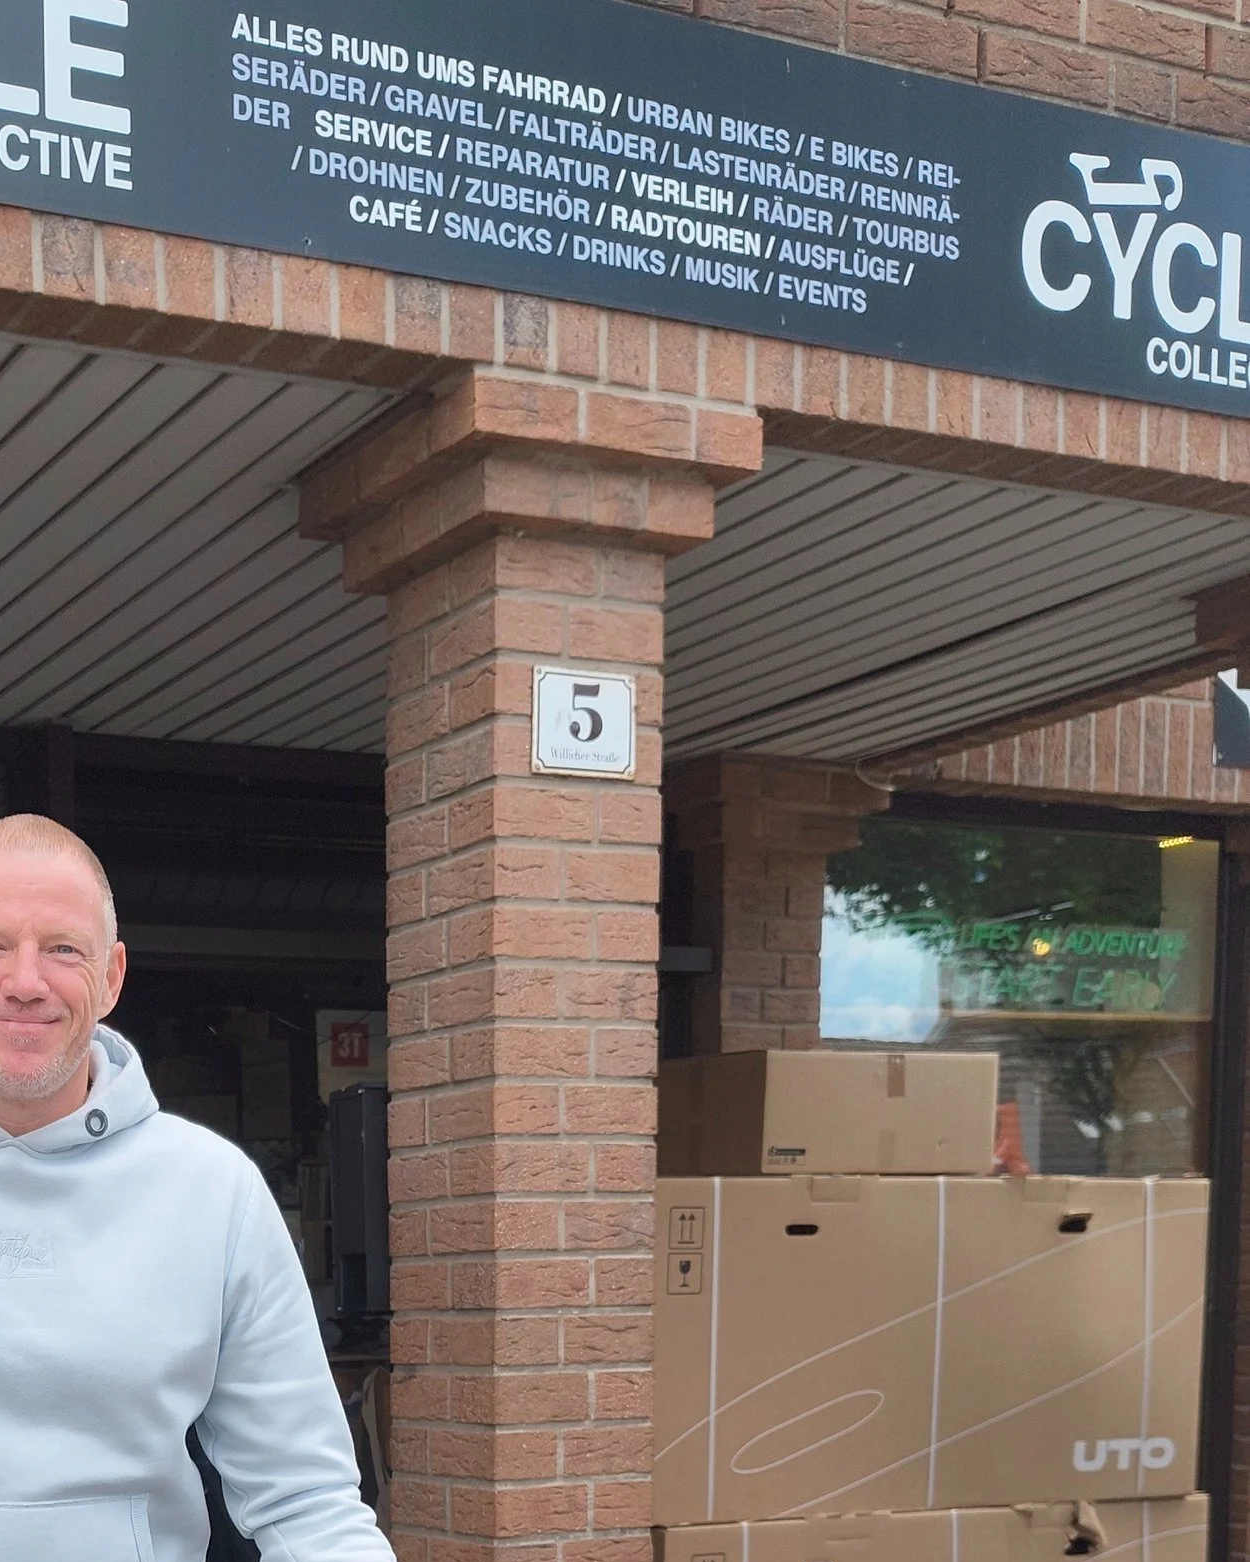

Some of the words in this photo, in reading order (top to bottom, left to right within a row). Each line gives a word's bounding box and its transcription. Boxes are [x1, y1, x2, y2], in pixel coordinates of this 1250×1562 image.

[231, 13, 323, 56] ALLES
[331, 33, 409, 74] RUND
[417, 53, 475, 88] UMS
[483, 65, 606, 114] FAHRRAD
[627, 96, 712, 138] URBAN
[721, 116, 790, 154] BIKES
[811, 137, 824, 162] E
[832, 142, 900, 179] BIKES
[232, 53, 366, 106] SERÄDER
[384, 84, 493, 130] GRAVEL
[510, 110, 656, 162] FALTRÄDER
[673, 143, 845, 202] LASTENRÄDER
[232, 93, 291, 129] DER
[314, 109, 433, 157] SERVICE
[456, 137, 610, 190] REPARATUR
[630, 171, 734, 216] VERLEIH
[753, 195, 834, 237] RÄDER
[853, 217, 960, 261] TOURBUS
[308, 148, 444, 198] DROHNEN
[465, 177, 591, 224] ZUBEHÖR
[610, 205, 761, 258] RADTOUREN
[778, 238, 900, 285] AUSFLÜGE
[349, 195, 423, 233] CAFÉ
[443, 211, 552, 255] SNACKS
[572, 235, 666, 276] DRINKS
[685, 256, 761, 294] MUSIK
[778, 274, 868, 314] EVENTS
[1146, 337, 1250, 389] COLLE
[569, 683, 603, 742] 5
[1073, 1437, 1175, 1471] UTO
